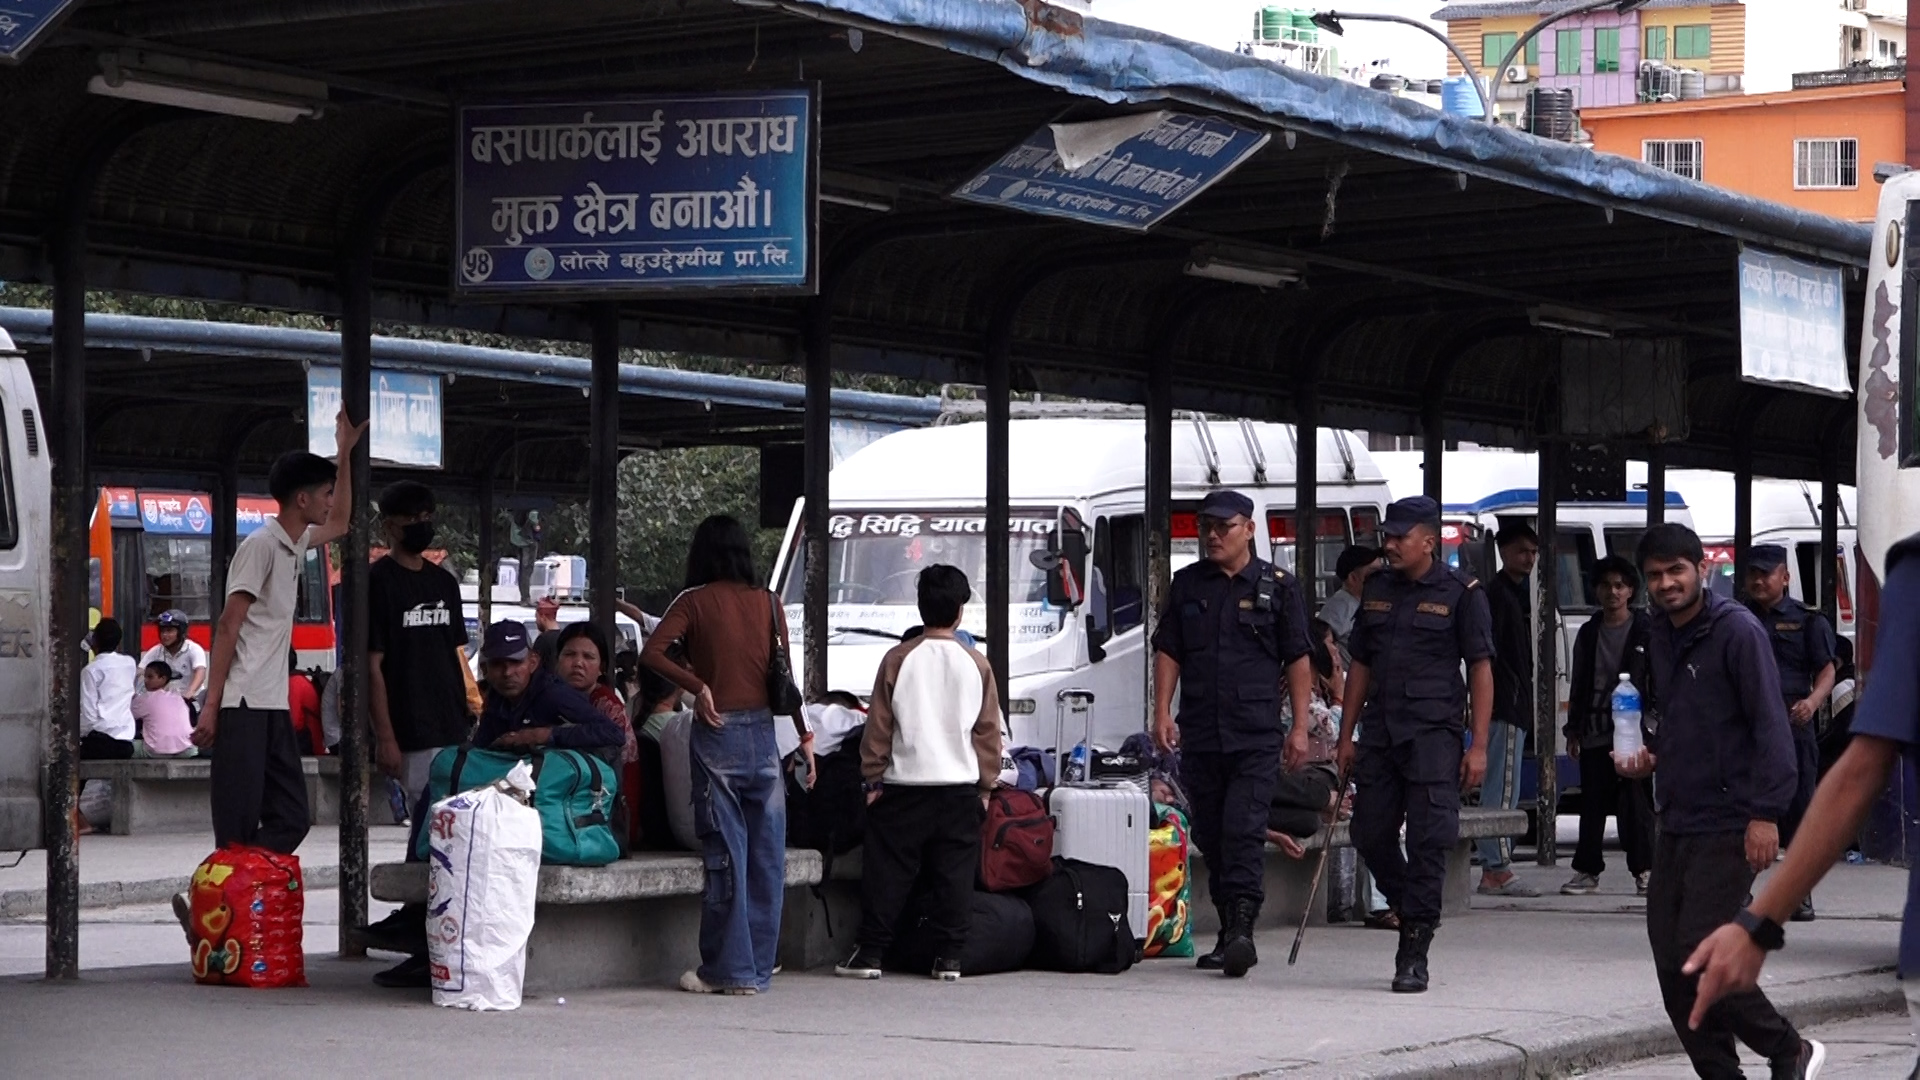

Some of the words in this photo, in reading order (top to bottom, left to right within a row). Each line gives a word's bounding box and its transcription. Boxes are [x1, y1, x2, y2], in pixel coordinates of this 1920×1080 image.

[471, 109, 665, 166] बसपार्कलाई
[675, 115, 798, 160] अपराध
[491, 196, 564, 247] मुक्त
[573, 181, 640, 238] क्षेत्र
[465, 251, 491, 280] ५४
[559, 250, 610, 271] लोत्से
